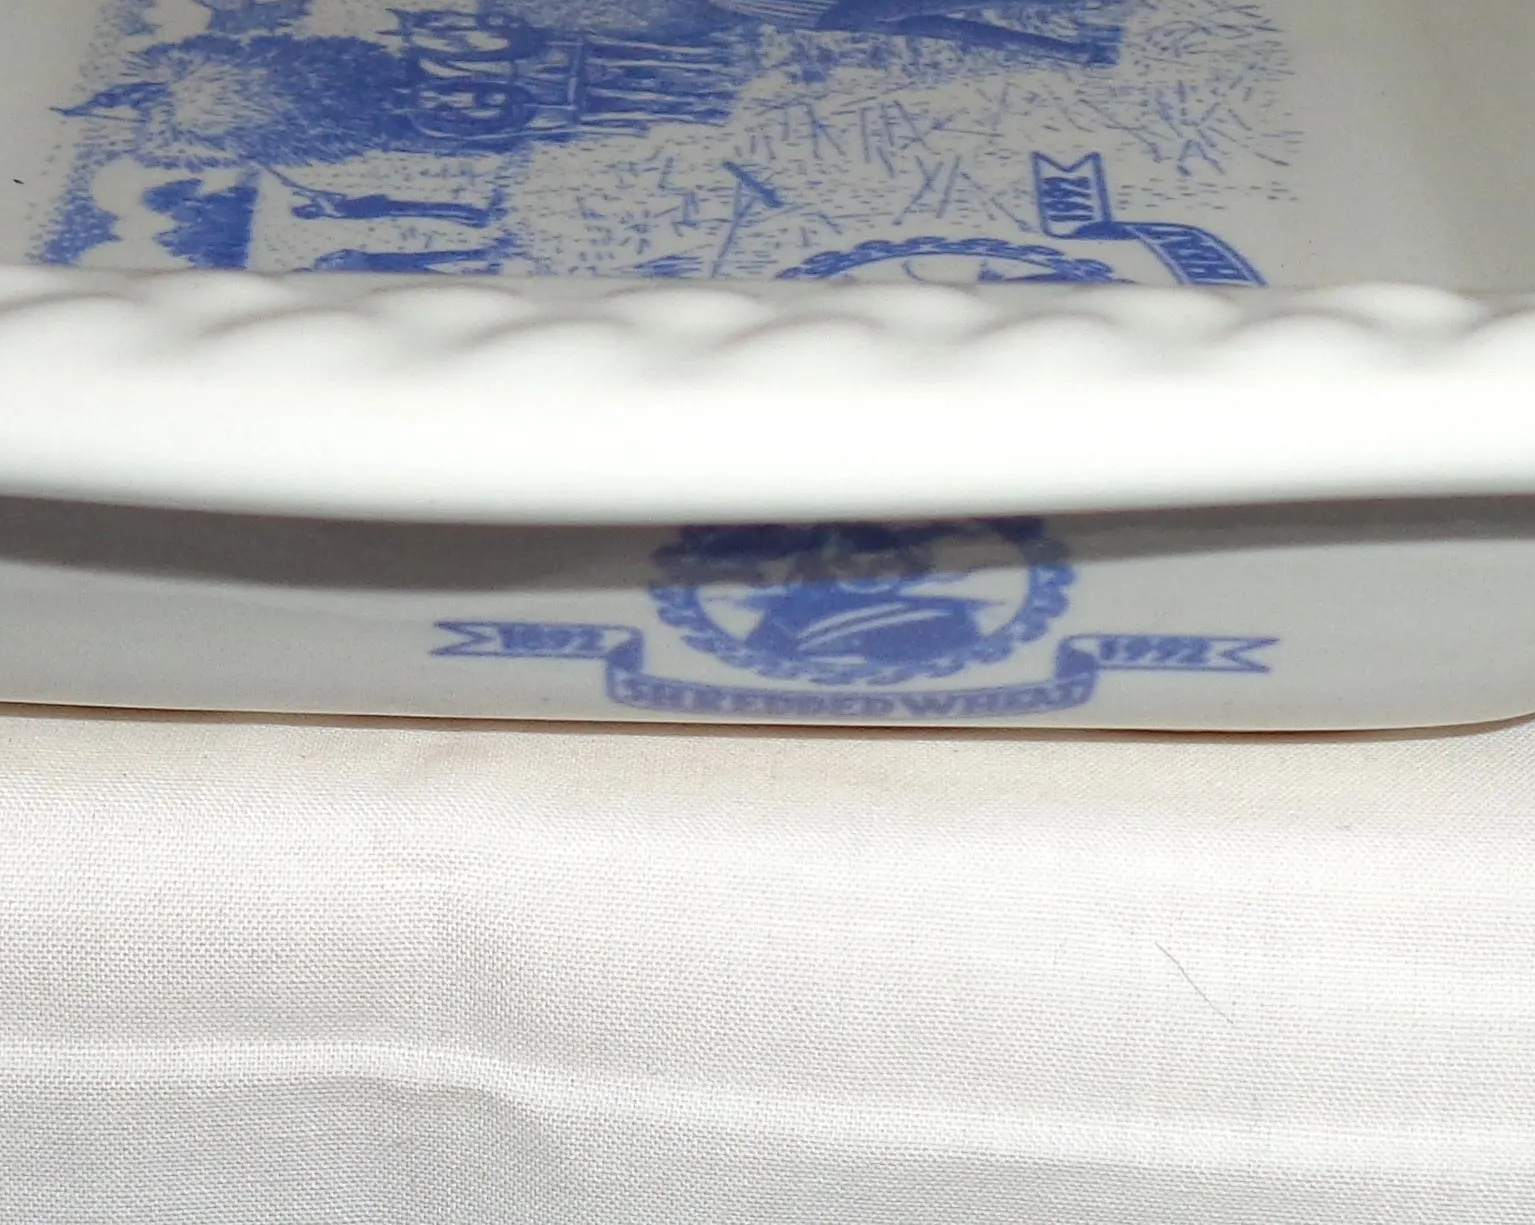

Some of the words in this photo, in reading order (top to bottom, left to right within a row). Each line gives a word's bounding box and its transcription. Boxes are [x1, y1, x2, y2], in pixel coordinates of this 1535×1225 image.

[1041, 176, 1095, 222] 1992
[498, 624, 606, 653] 1892
[1098, 638, 1212, 666] 1992
[617, 675, 894, 717] SHREDDED
[900, 672, 1089, 717] WHEAT
